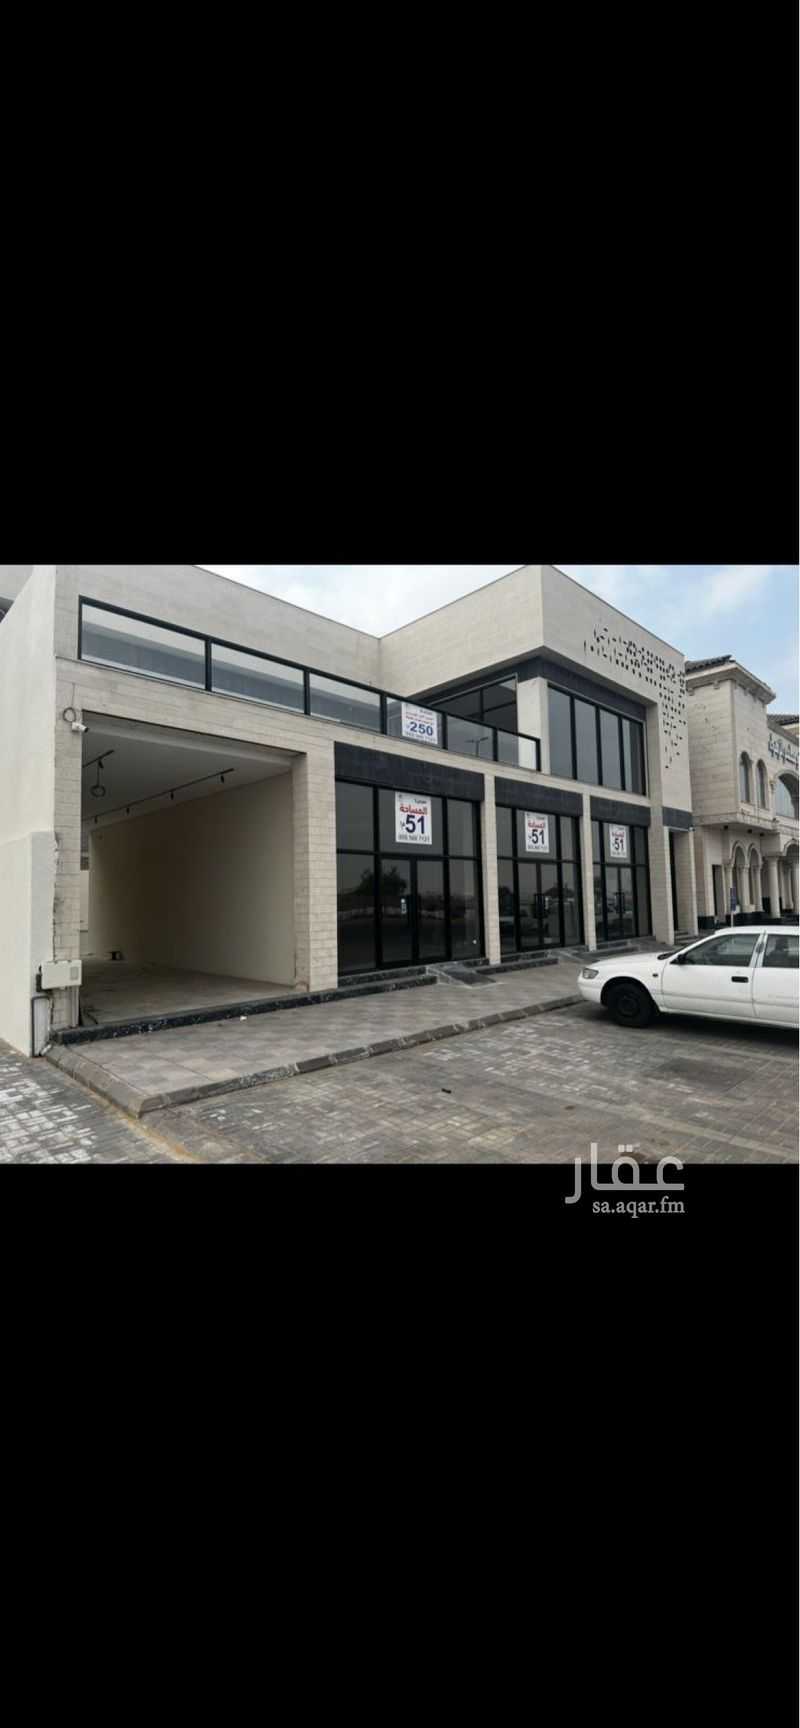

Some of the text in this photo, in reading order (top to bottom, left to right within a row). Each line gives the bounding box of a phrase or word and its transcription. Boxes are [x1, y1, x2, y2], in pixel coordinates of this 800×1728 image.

[410, 721, 433, 736] 250
[405, 814, 425, 834] 51
[531, 829, 545, 845] 51
[614, 837, 624, 850] 51
